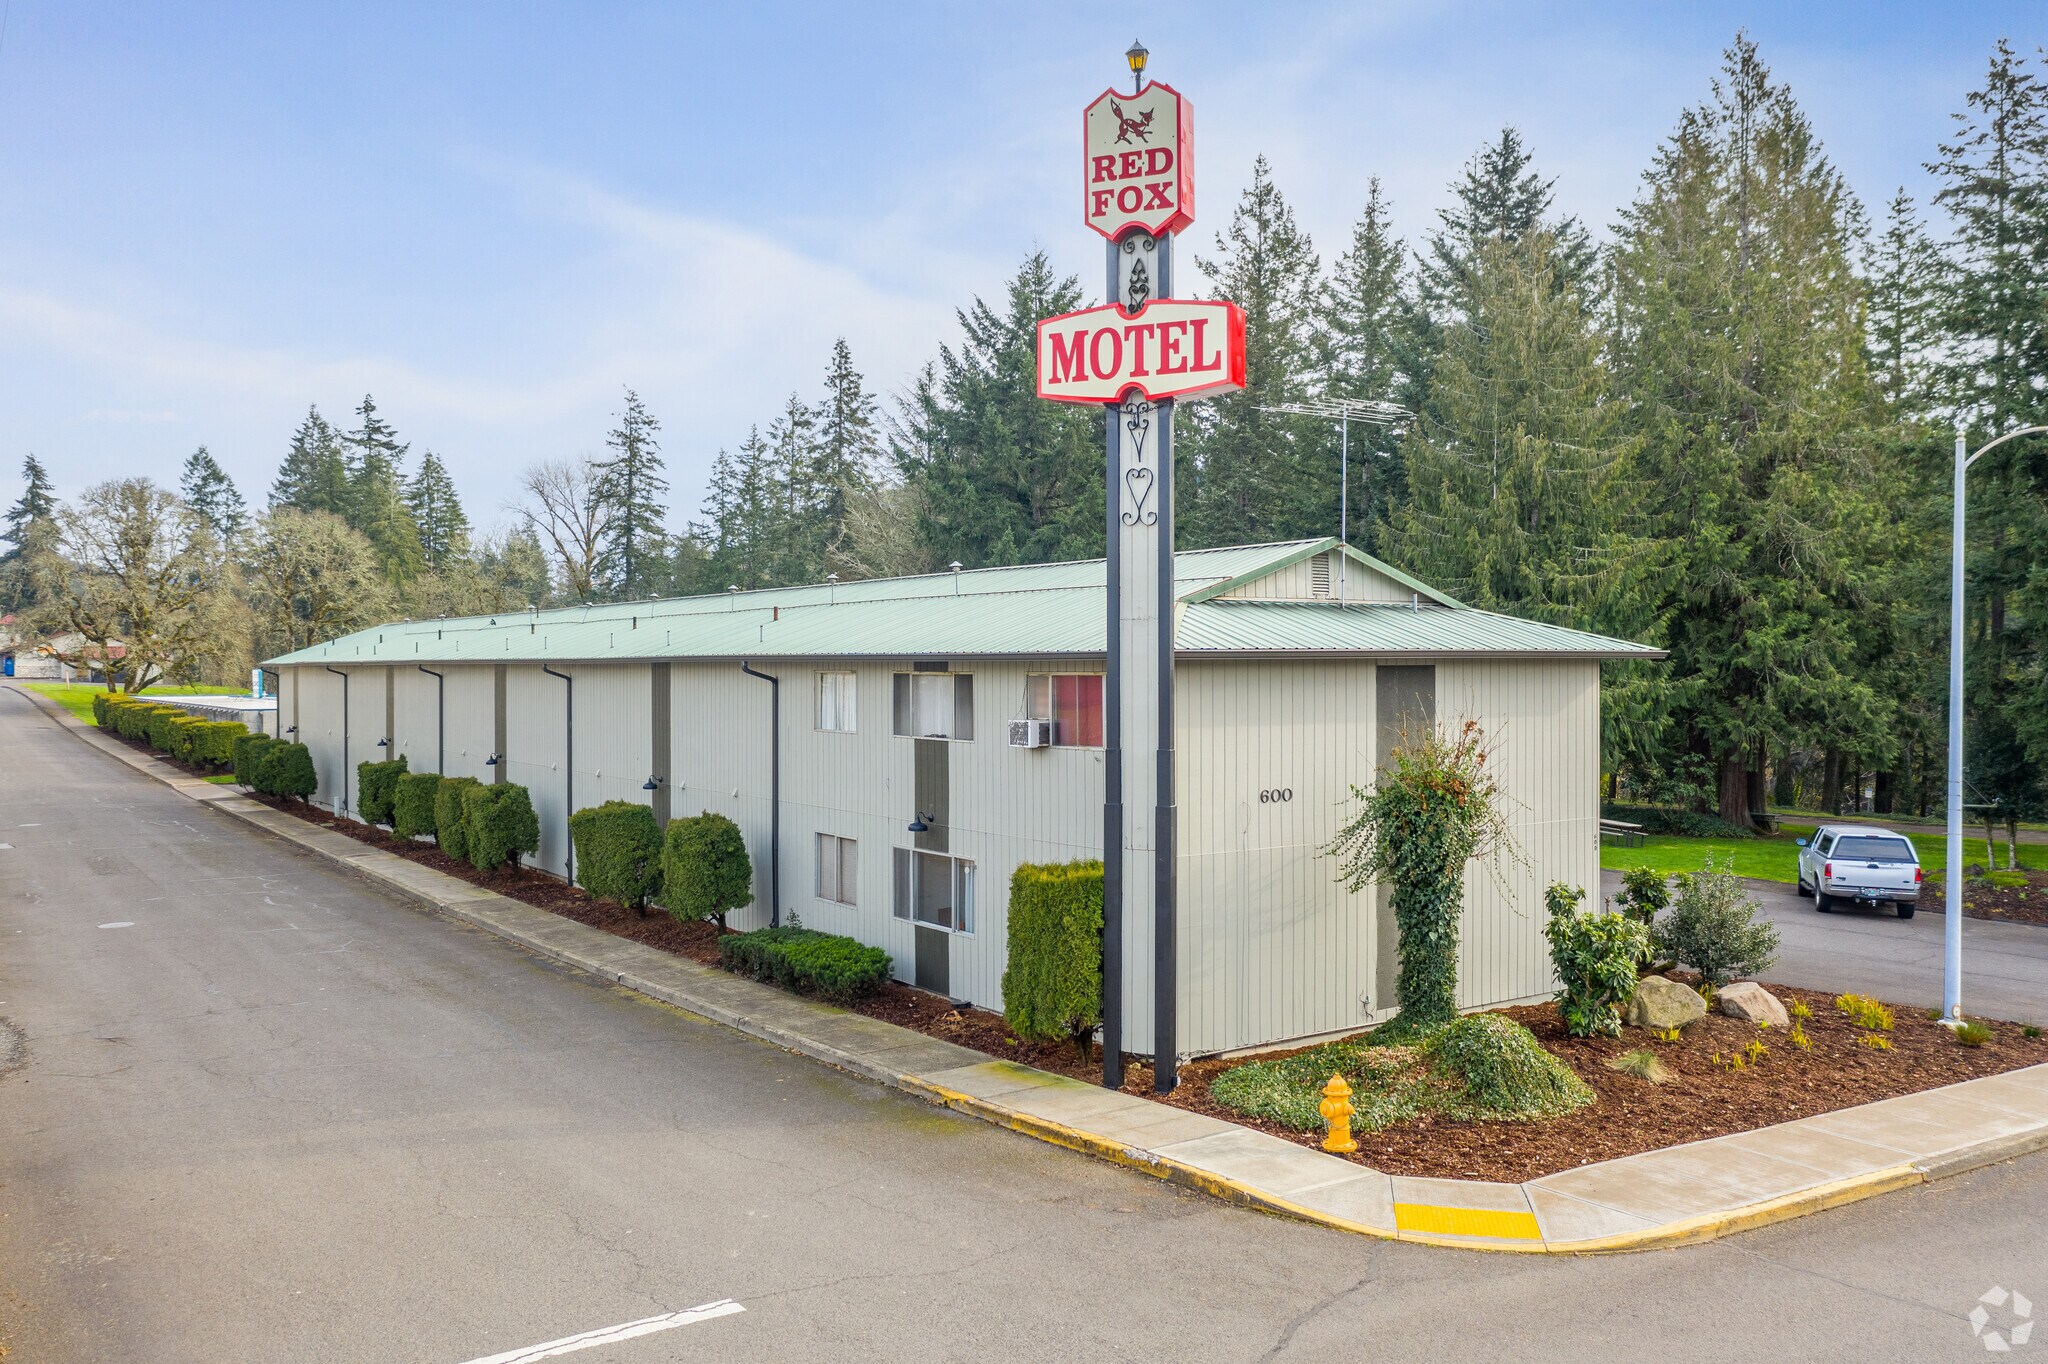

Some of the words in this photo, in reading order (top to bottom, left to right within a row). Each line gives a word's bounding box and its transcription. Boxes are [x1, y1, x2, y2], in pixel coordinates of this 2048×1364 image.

[1092, 147, 1174, 183] RED
[1091, 181, 1175, 217] FOX
[1048, 318, 1222, 385] MOTEL
[1260, 788, 1293, 803] 600
